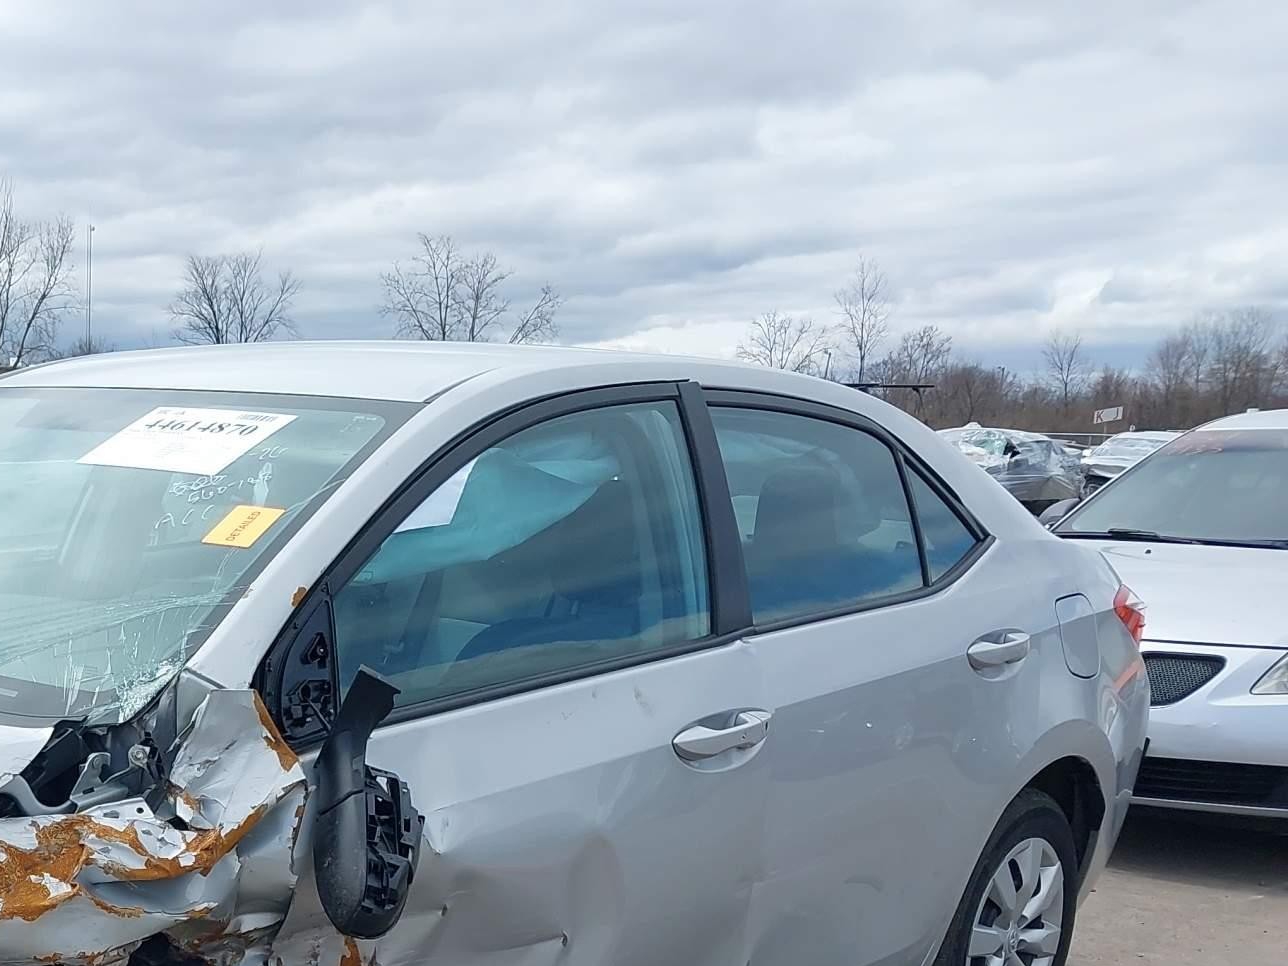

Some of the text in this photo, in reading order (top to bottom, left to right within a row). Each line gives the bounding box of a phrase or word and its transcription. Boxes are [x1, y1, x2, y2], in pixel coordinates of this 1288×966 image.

[1096, 408, 1119, 422] K J
[145, 419, 259, 436] 44614870
[225, 511, 261, 542] DETAILED
